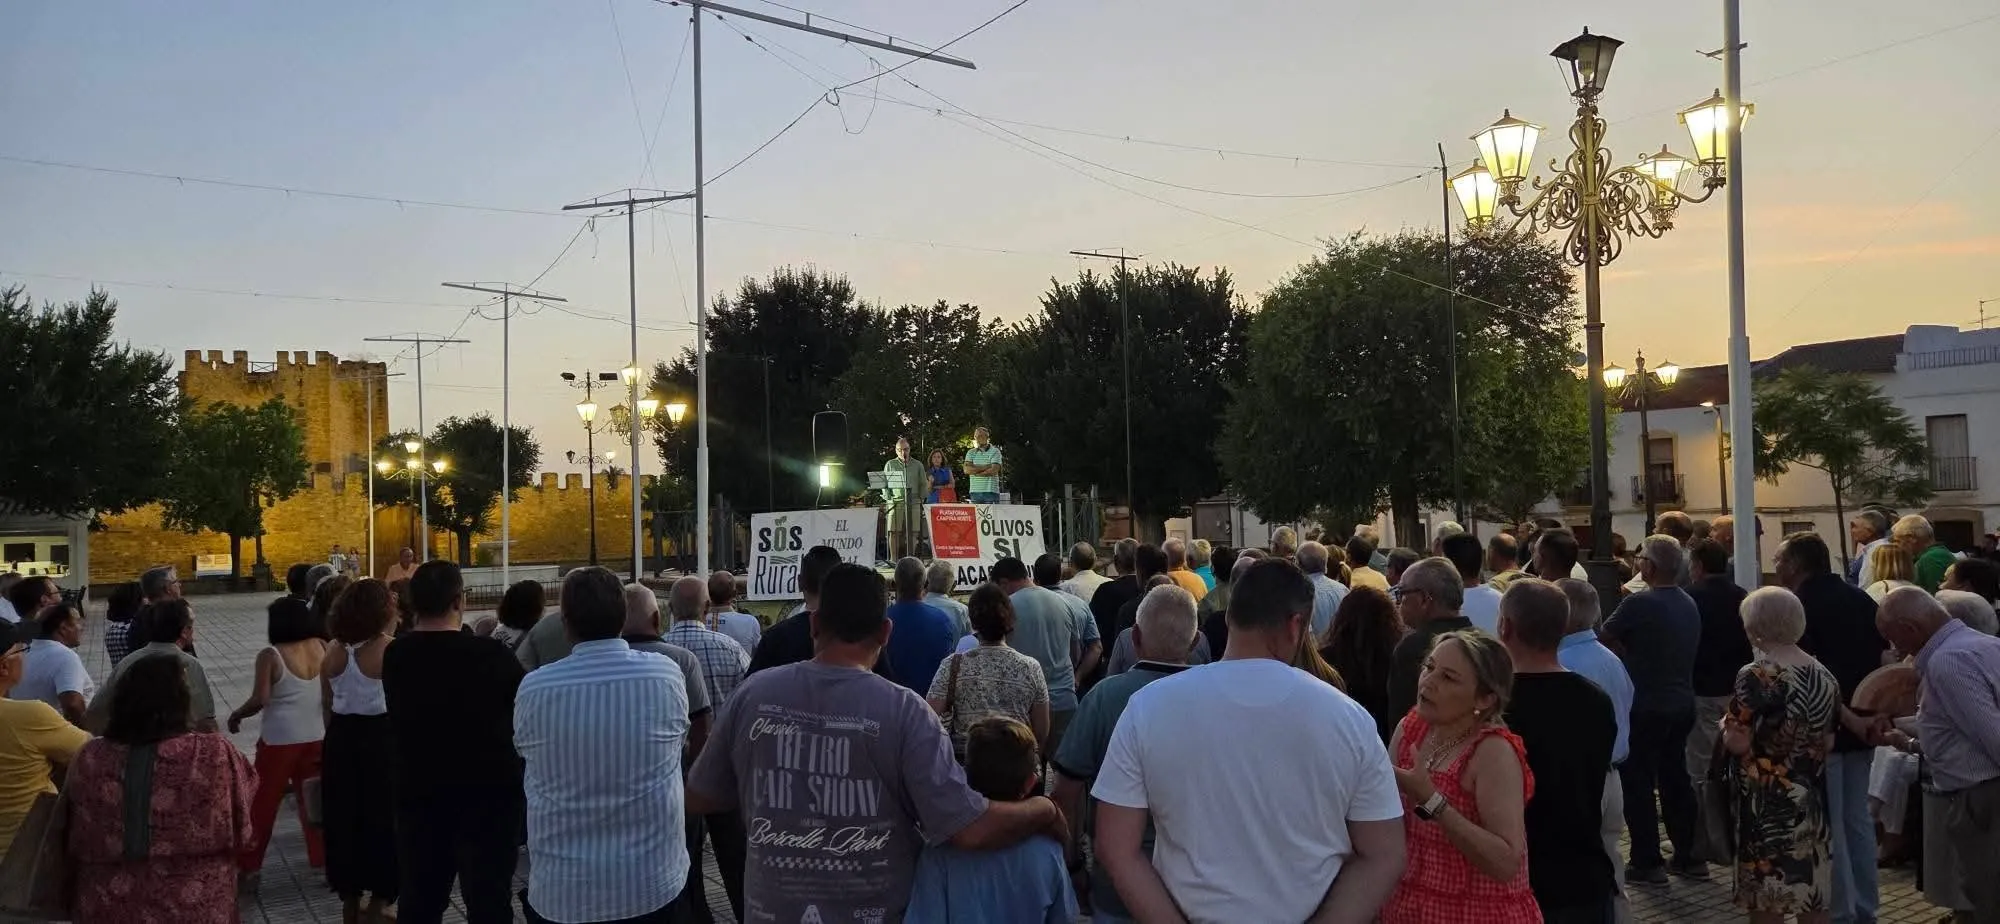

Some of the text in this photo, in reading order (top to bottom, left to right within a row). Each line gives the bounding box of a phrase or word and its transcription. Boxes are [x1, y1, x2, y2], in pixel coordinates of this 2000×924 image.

[836, 520, 849, 532] EL
[981, 519, 1034, 536] OLIVOS
[754, 554, 805, 595] Rura
[749, 717, 800, 741] Classic
[777, 731, 851, 776] RETRO
[752, 768, 884, 817] CAR SHOW
[748, 817, 827, 849] Borcelle
